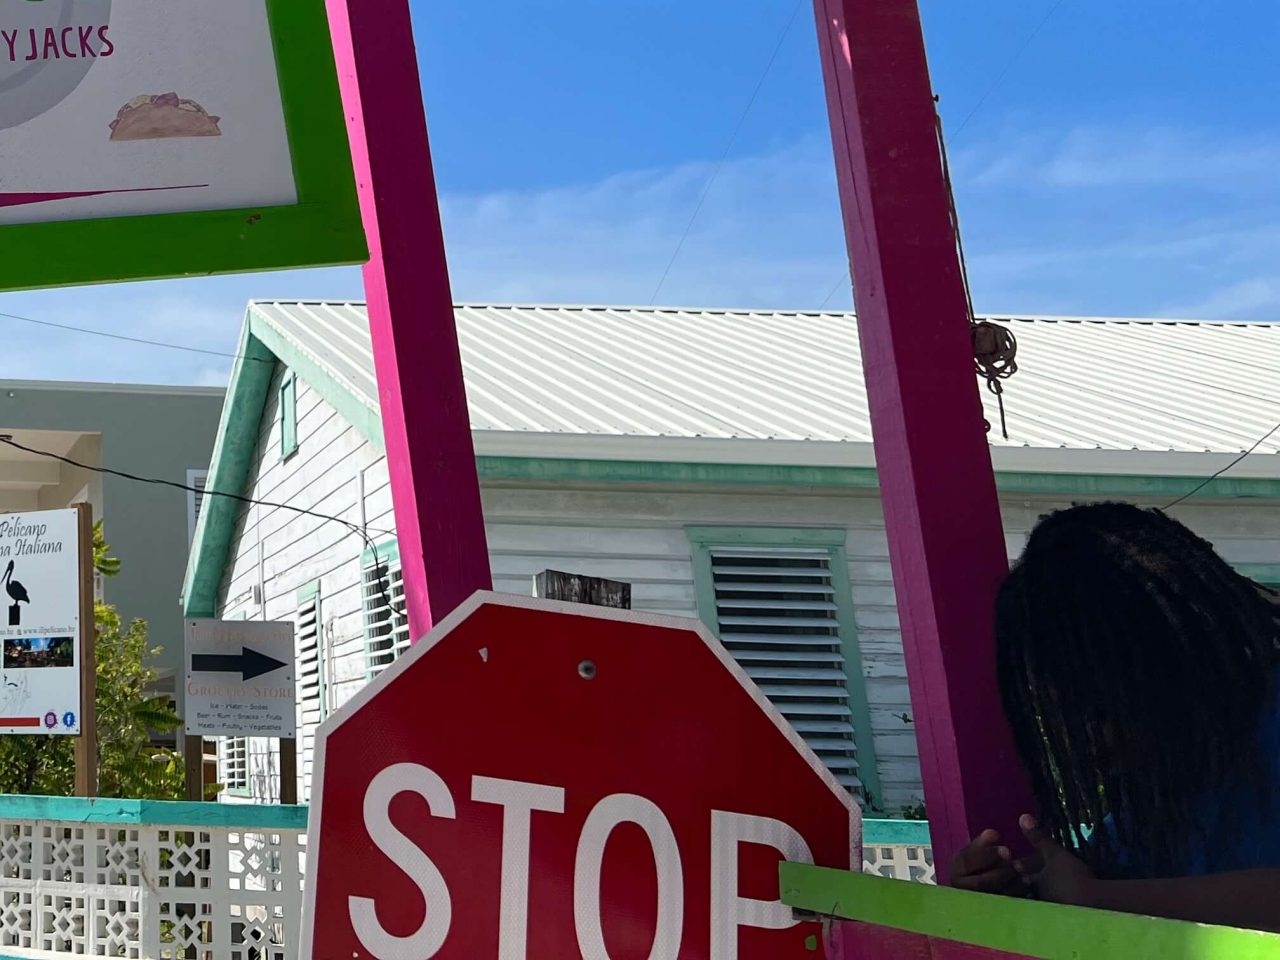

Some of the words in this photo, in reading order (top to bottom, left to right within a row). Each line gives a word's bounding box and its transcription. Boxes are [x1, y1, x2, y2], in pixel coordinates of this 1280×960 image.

[25, 25, 115, 61] JACKS
[0, 516, 48, 538] Pelicano
[15, 537, 62, 557] Italiana
[348, 761, 816, 960] STOP
